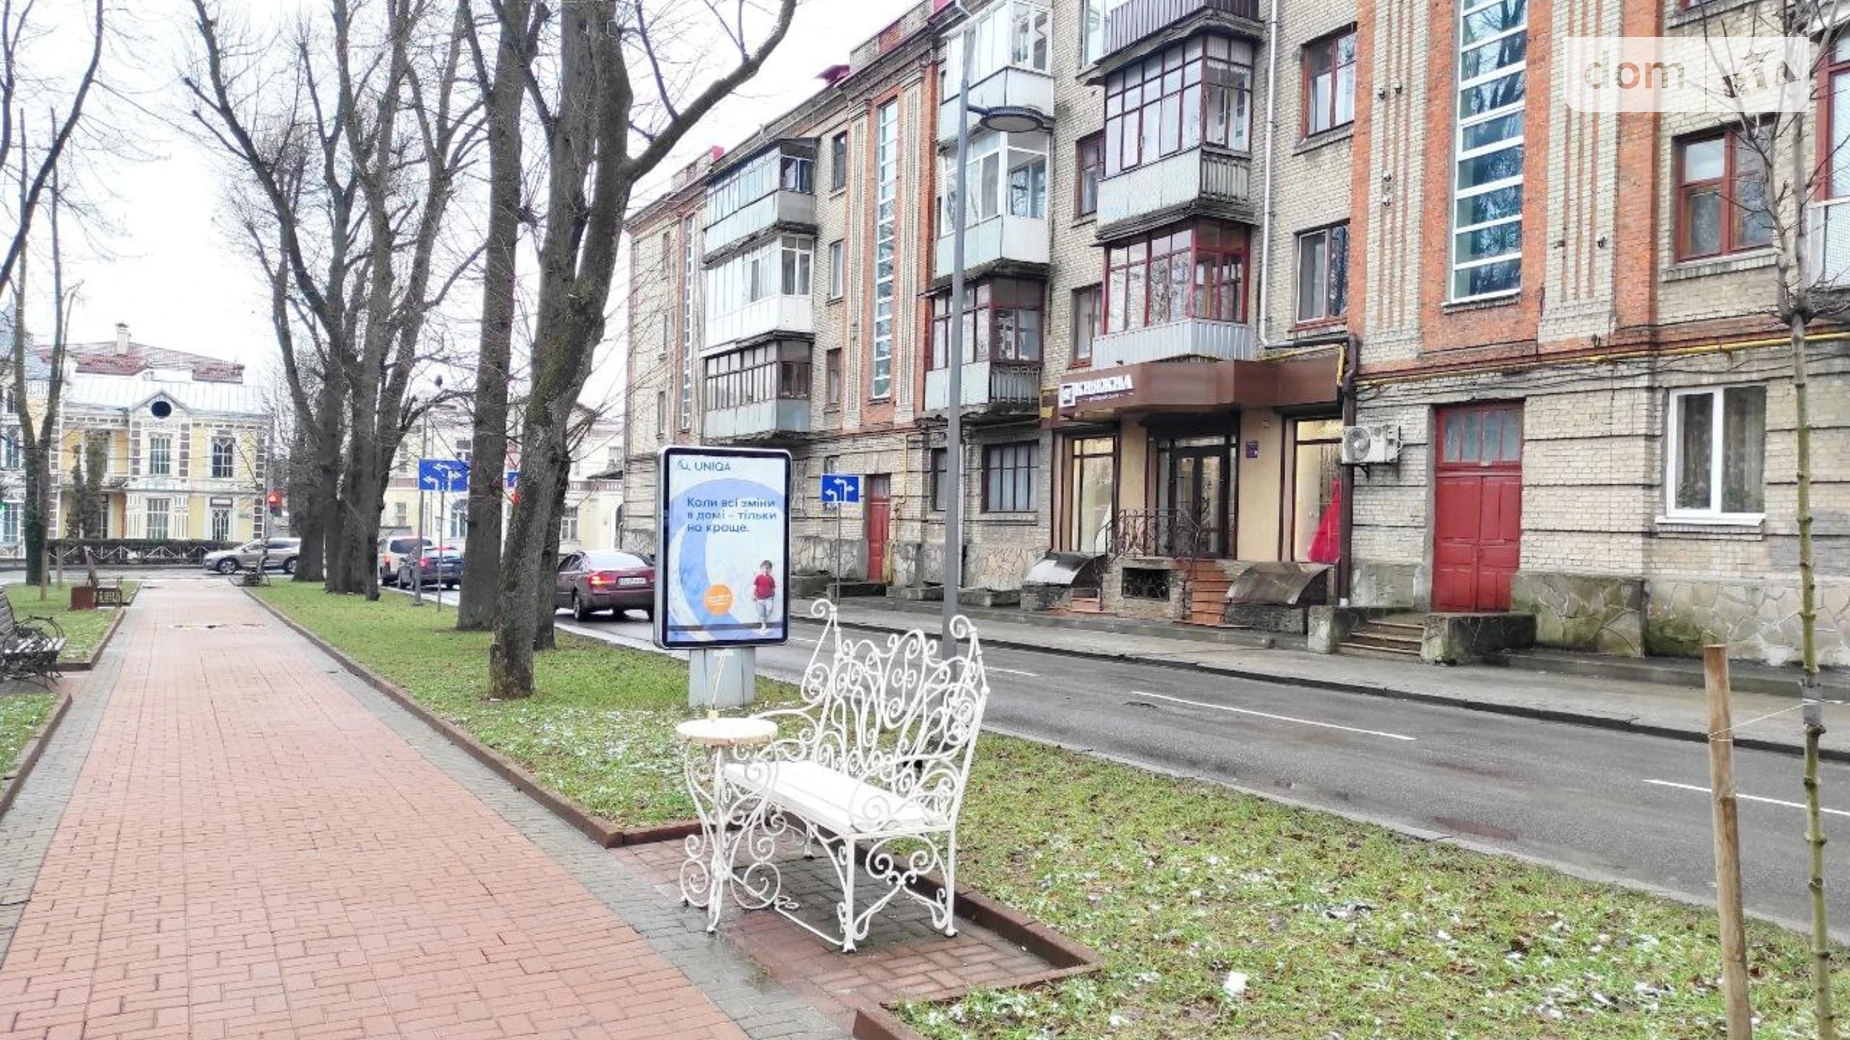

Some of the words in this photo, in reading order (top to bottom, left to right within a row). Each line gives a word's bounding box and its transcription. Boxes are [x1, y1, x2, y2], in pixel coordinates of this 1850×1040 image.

[694, 461, 731, 471] UNIQA
[687, 498, 718, 508] Коли
[721, 498, 738, 508] всі
[741, 498, 776, 508] зміни
[696, 510, 725, 521] домі
[738, 510, 777, 520] тільки
[687, 524, 702, 532] на
[706, 524, 750, 533] краще.
